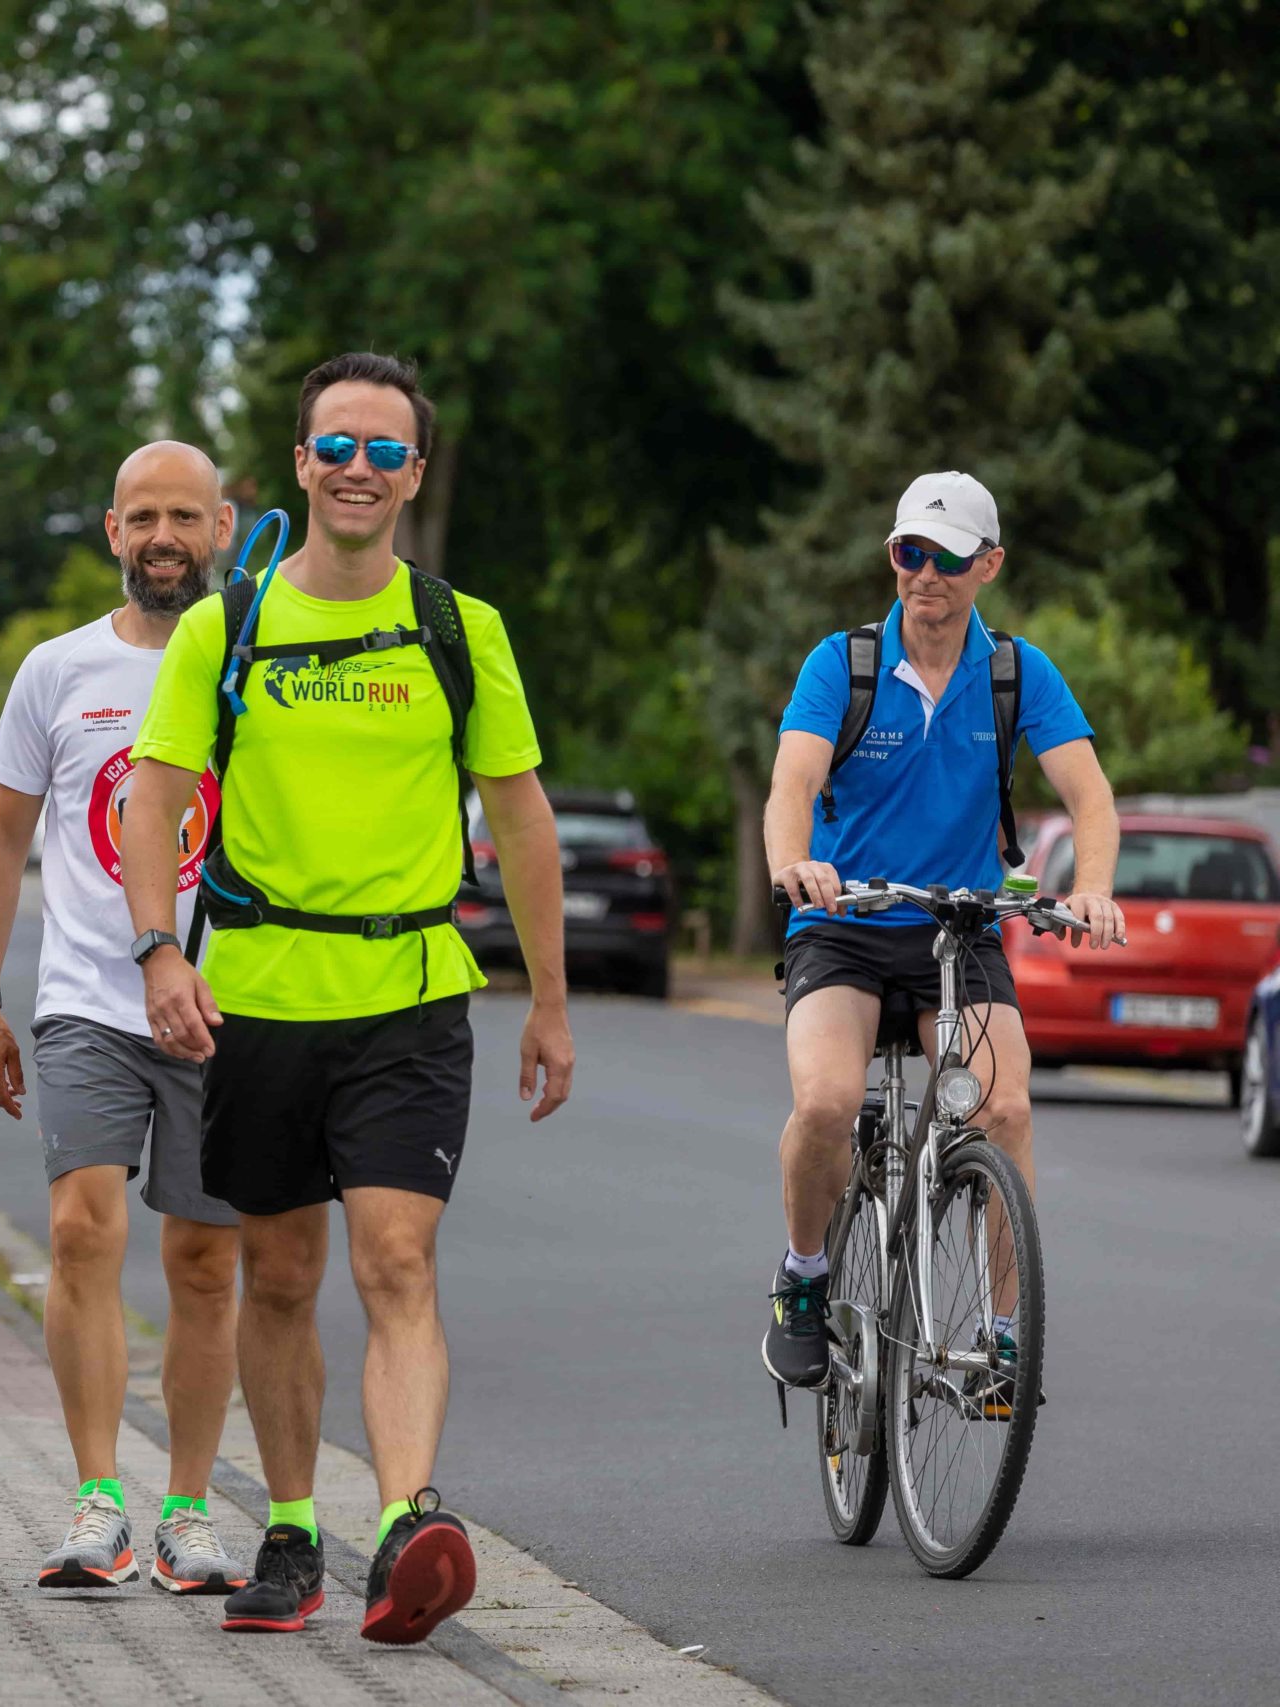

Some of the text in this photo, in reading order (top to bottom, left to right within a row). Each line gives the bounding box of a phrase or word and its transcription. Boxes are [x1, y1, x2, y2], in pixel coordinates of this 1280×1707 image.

[292, 680, 410, 704] WORLD RUN
[81, 708, 131, 720] molitor
[369, 704, 410, 712] 2017
[104, 757, 128, 782] ICH
